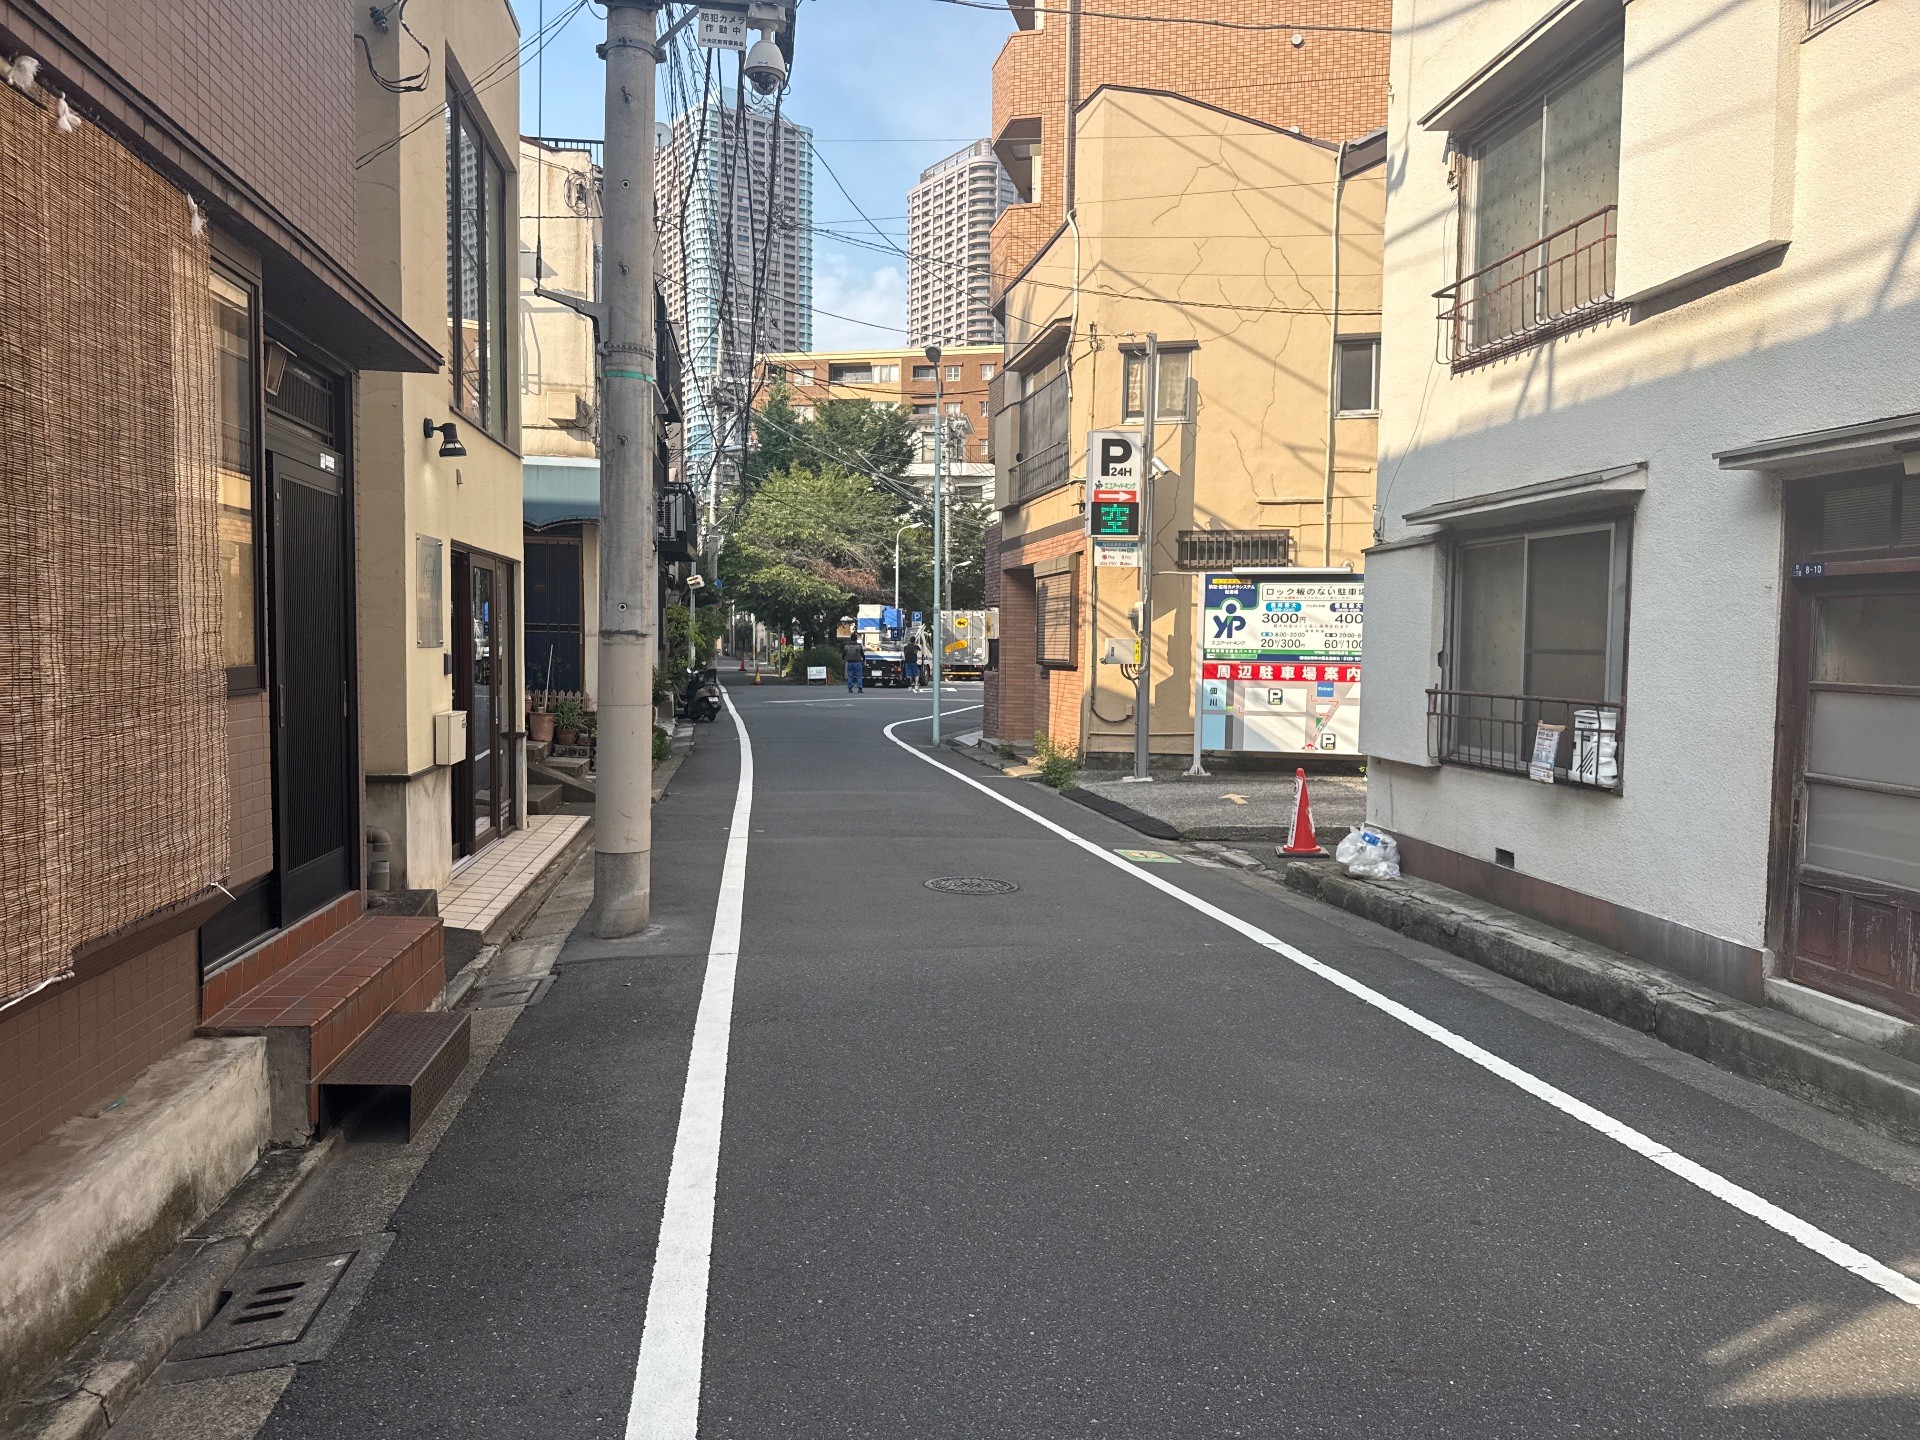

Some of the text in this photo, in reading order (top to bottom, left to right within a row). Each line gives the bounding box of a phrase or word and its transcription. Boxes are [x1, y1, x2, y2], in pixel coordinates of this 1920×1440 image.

[701, 12, 746, 25] 防犯カメラ
[705, 24, 741, 35] 作動中
[1101, 438, 1133, 477] P
[1110, 467, 1132, 477] 24H
[1100, 503, 1130, 533] 空
[1805, 564, 1822, 574] 8-10
[1216, 664, 1361, 682] 周辺駐車場案内
